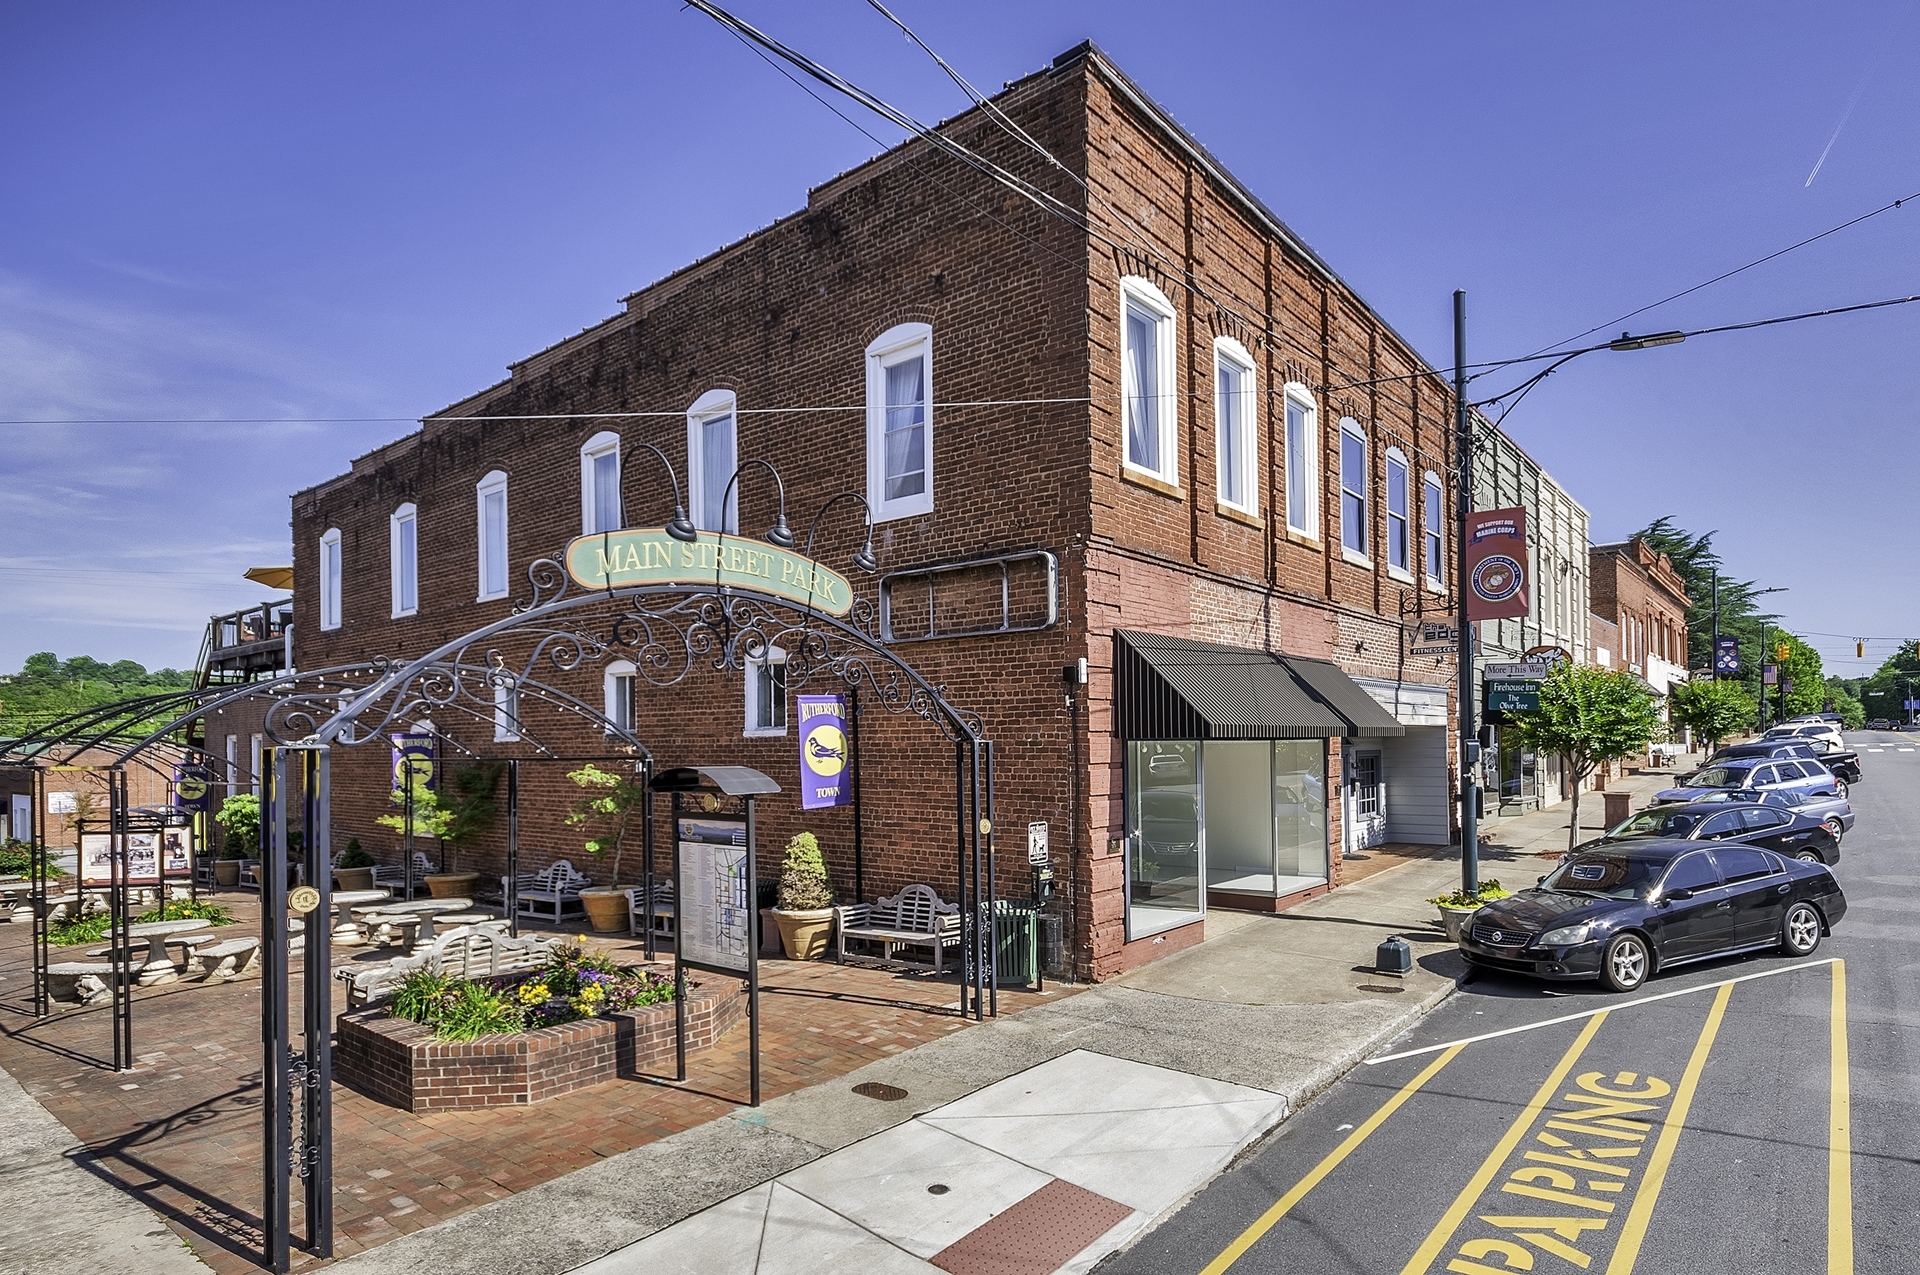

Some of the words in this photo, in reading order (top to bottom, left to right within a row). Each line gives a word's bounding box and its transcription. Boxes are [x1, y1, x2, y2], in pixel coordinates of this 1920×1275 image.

[1475, 527, 1497, 538] MARINE
[596, 541, 673, 577] MAIN
[680, 542, 774, 579] STREET
[781, 557, 837, 604] PARK
[1487, 665, 1506, 674] More
[1508, 664, 1526, 673] This
[1528, 664, 1544, 675] Way
[1493, 683, 1525, 691] Firehouse
[1525, 683, 1536, 691] Inn
[1508, 694, 1519, 702] The
[1499, 702, 1514, 710] Olive
[1516, 702, 1528, 710] Tree
[801, 703, 846, 722] RUTHERFORD
[815, 786, 841, 798] TOWN
[1446, 1071, 1671, 1275] PARKING
